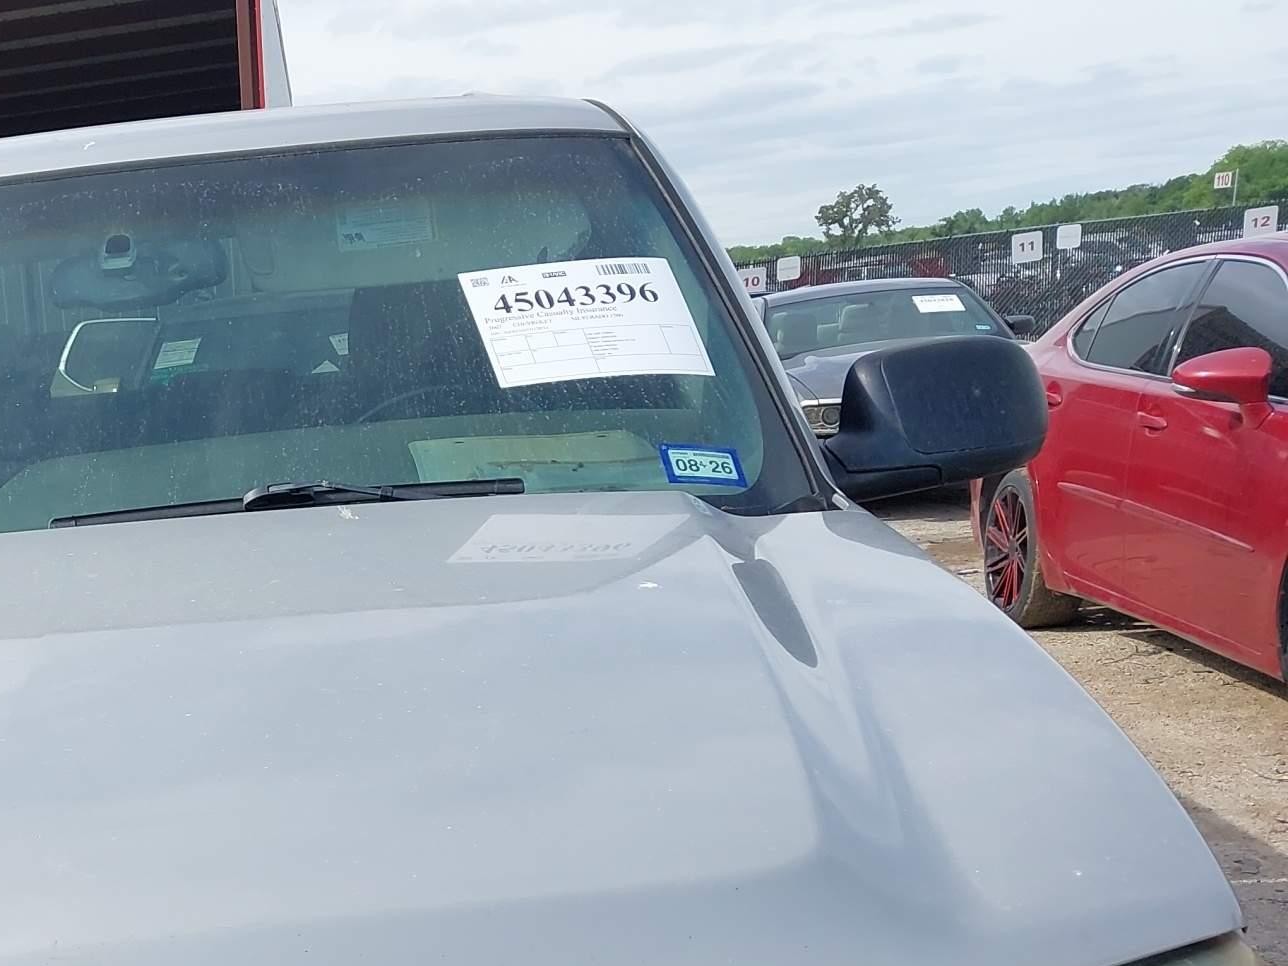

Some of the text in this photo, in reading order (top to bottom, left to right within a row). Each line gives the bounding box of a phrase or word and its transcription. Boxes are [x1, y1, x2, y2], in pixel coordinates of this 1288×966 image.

[1216, 173, 1230, 187] 110
[1251, 215, 1271, 228] 12
[1018, 240, 1035, 252] 11
[743, 276, 760, 288] 10
[493, 282, 659, 314] 45043396
[576, 305, 618, 313] Insurance
[675, 458, 733, 475] 08 26
